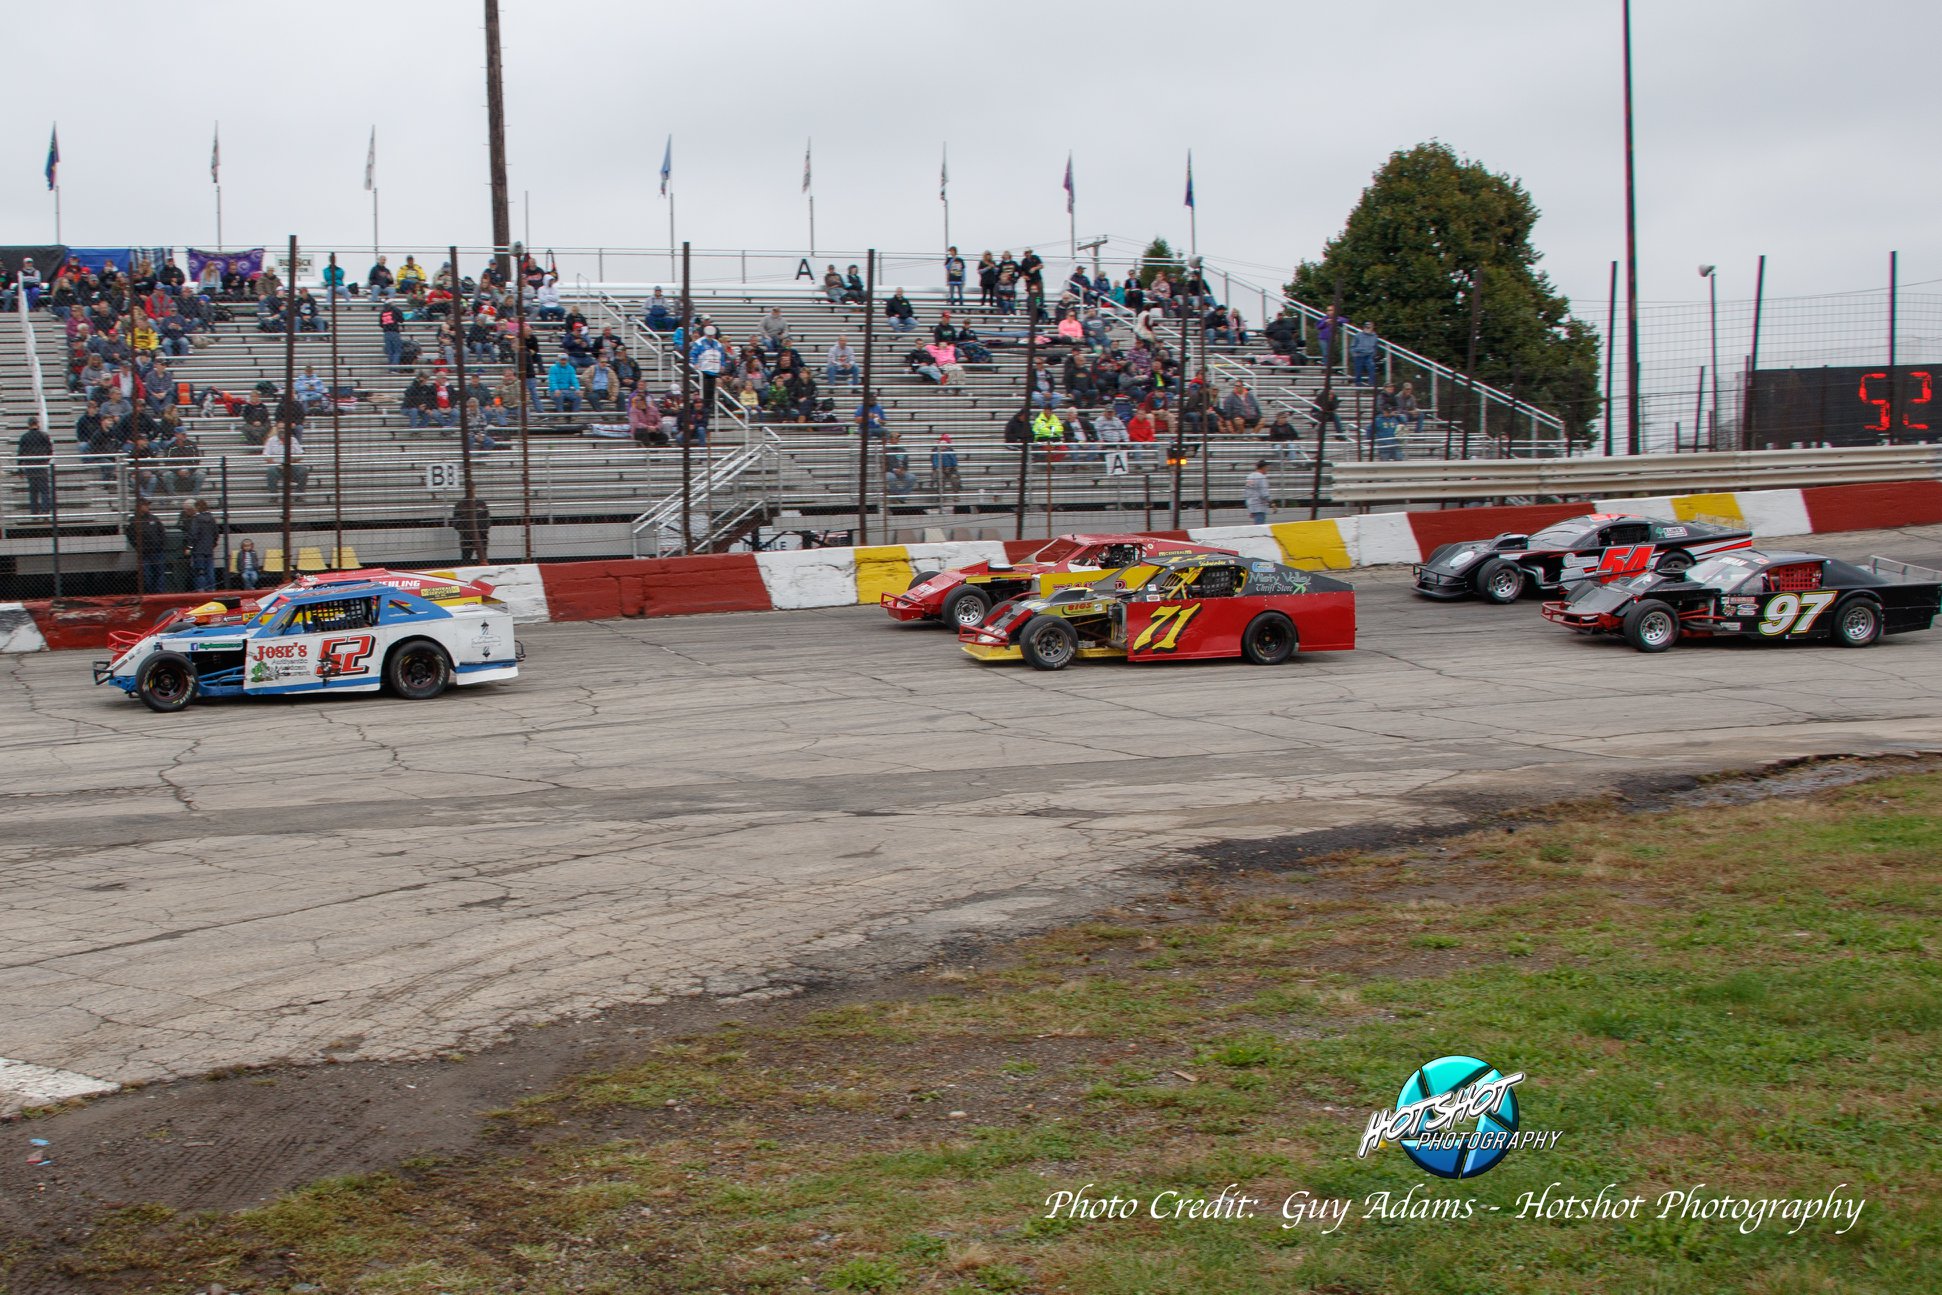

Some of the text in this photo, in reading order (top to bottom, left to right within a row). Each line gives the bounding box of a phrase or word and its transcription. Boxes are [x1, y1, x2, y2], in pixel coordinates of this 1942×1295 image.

[795, 258, 814, 280] A
[1858, 371, 1933, 432] 52
[1111, 454, 1126, 474] A
[1249, 572, 1280, 585] Misty
[1598, 544, 1657, 585] 54
[1255, 583, 1293, 593] Thrift Store
[1133, 602, 1205, 653] 71
[1758, 591, 1838, 636] 97
[253, 642, 308, 662] JOSE'S
[316, 634, 376, 678] 52
